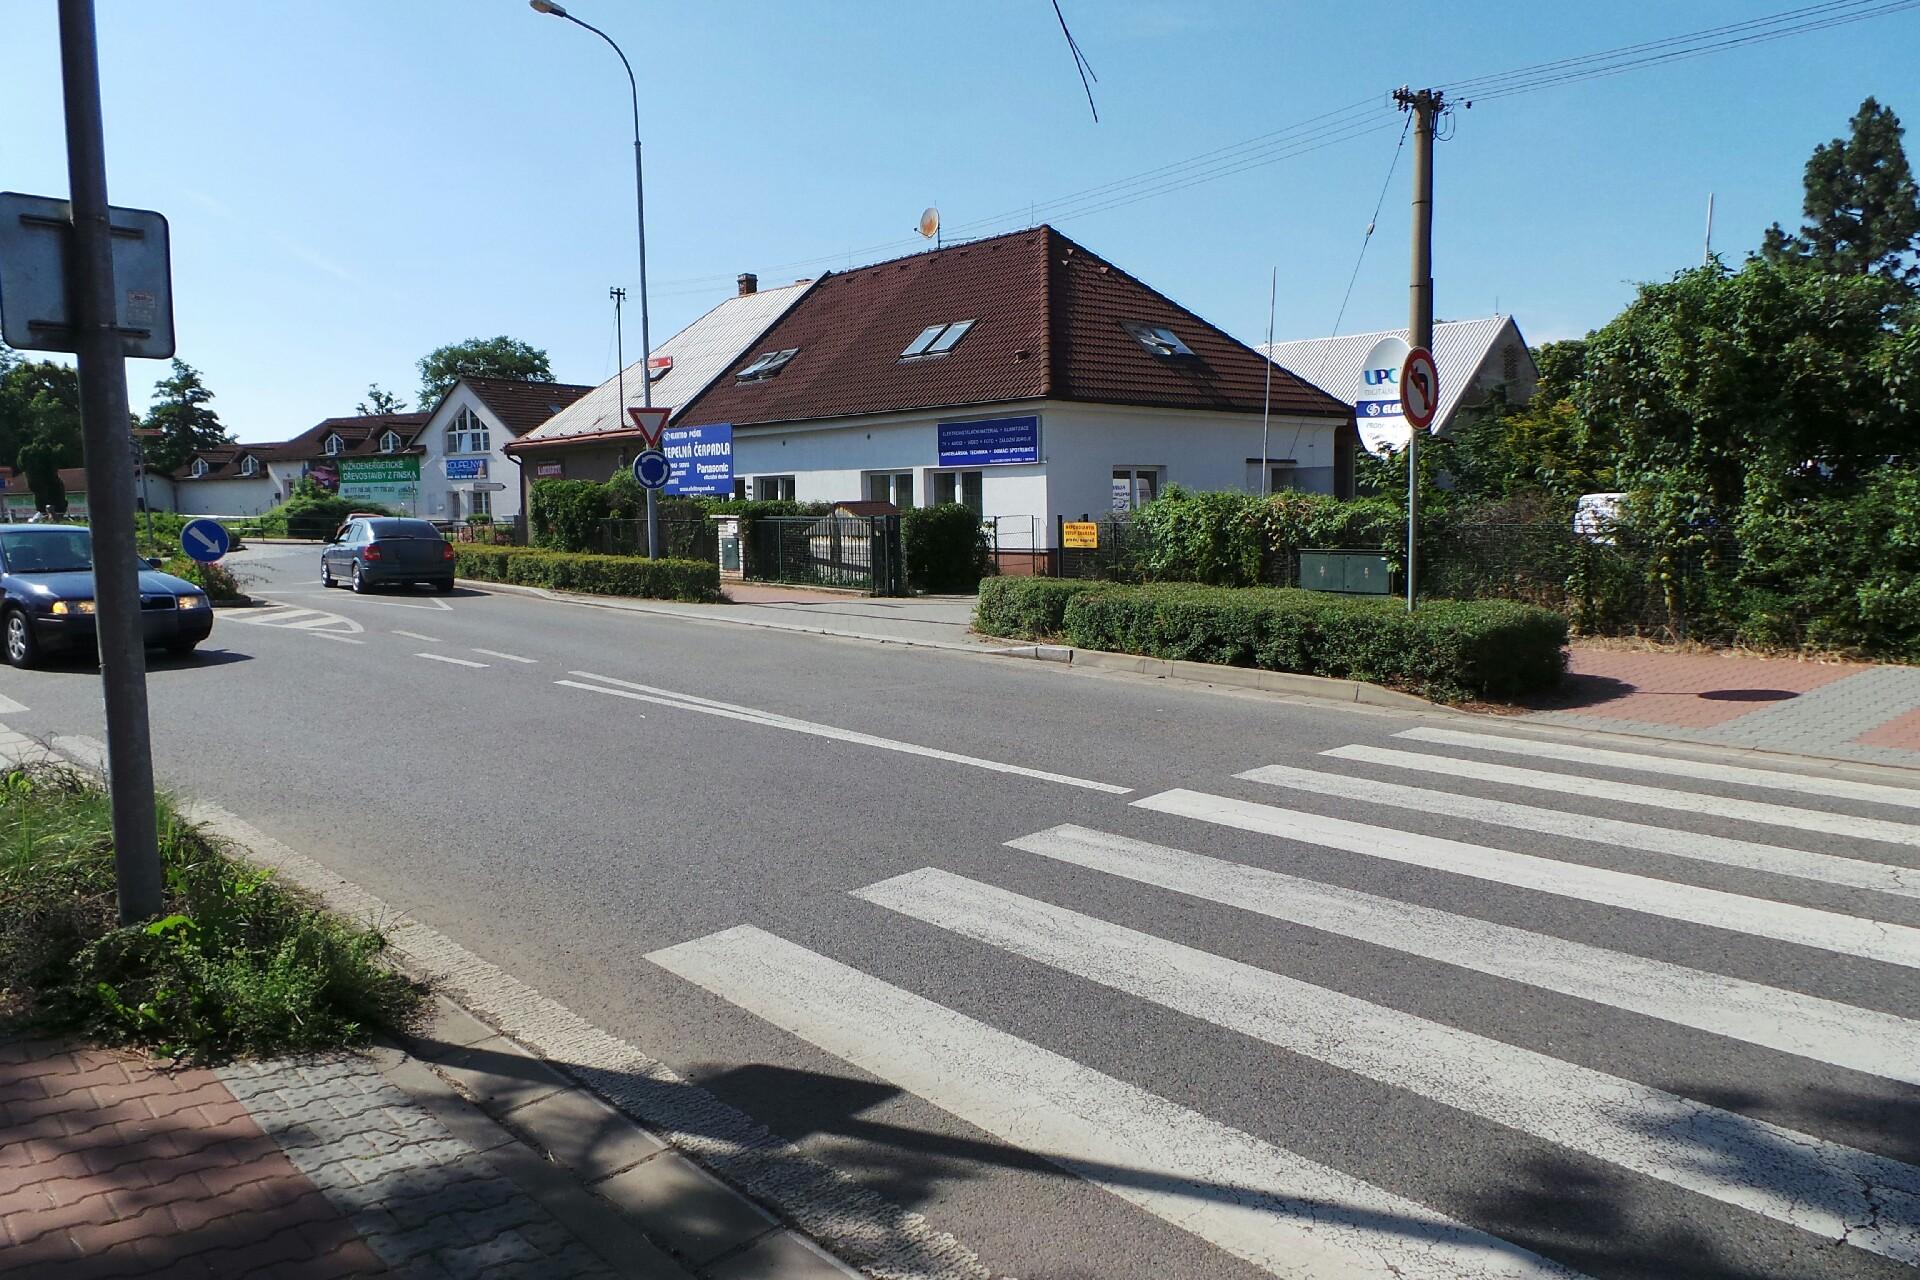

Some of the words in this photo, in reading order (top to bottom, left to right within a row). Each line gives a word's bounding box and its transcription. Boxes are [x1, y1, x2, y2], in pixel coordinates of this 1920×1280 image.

[1364, 368, 1398, 385] UPC
[664, 442, 691, 458] TEPELNÁ
[694, 441, 730, 456] ČERPADLA
[697, 463, 728, 473] Panasonic
[343, 471, 386, 480] DŘEVOSTAVBY
